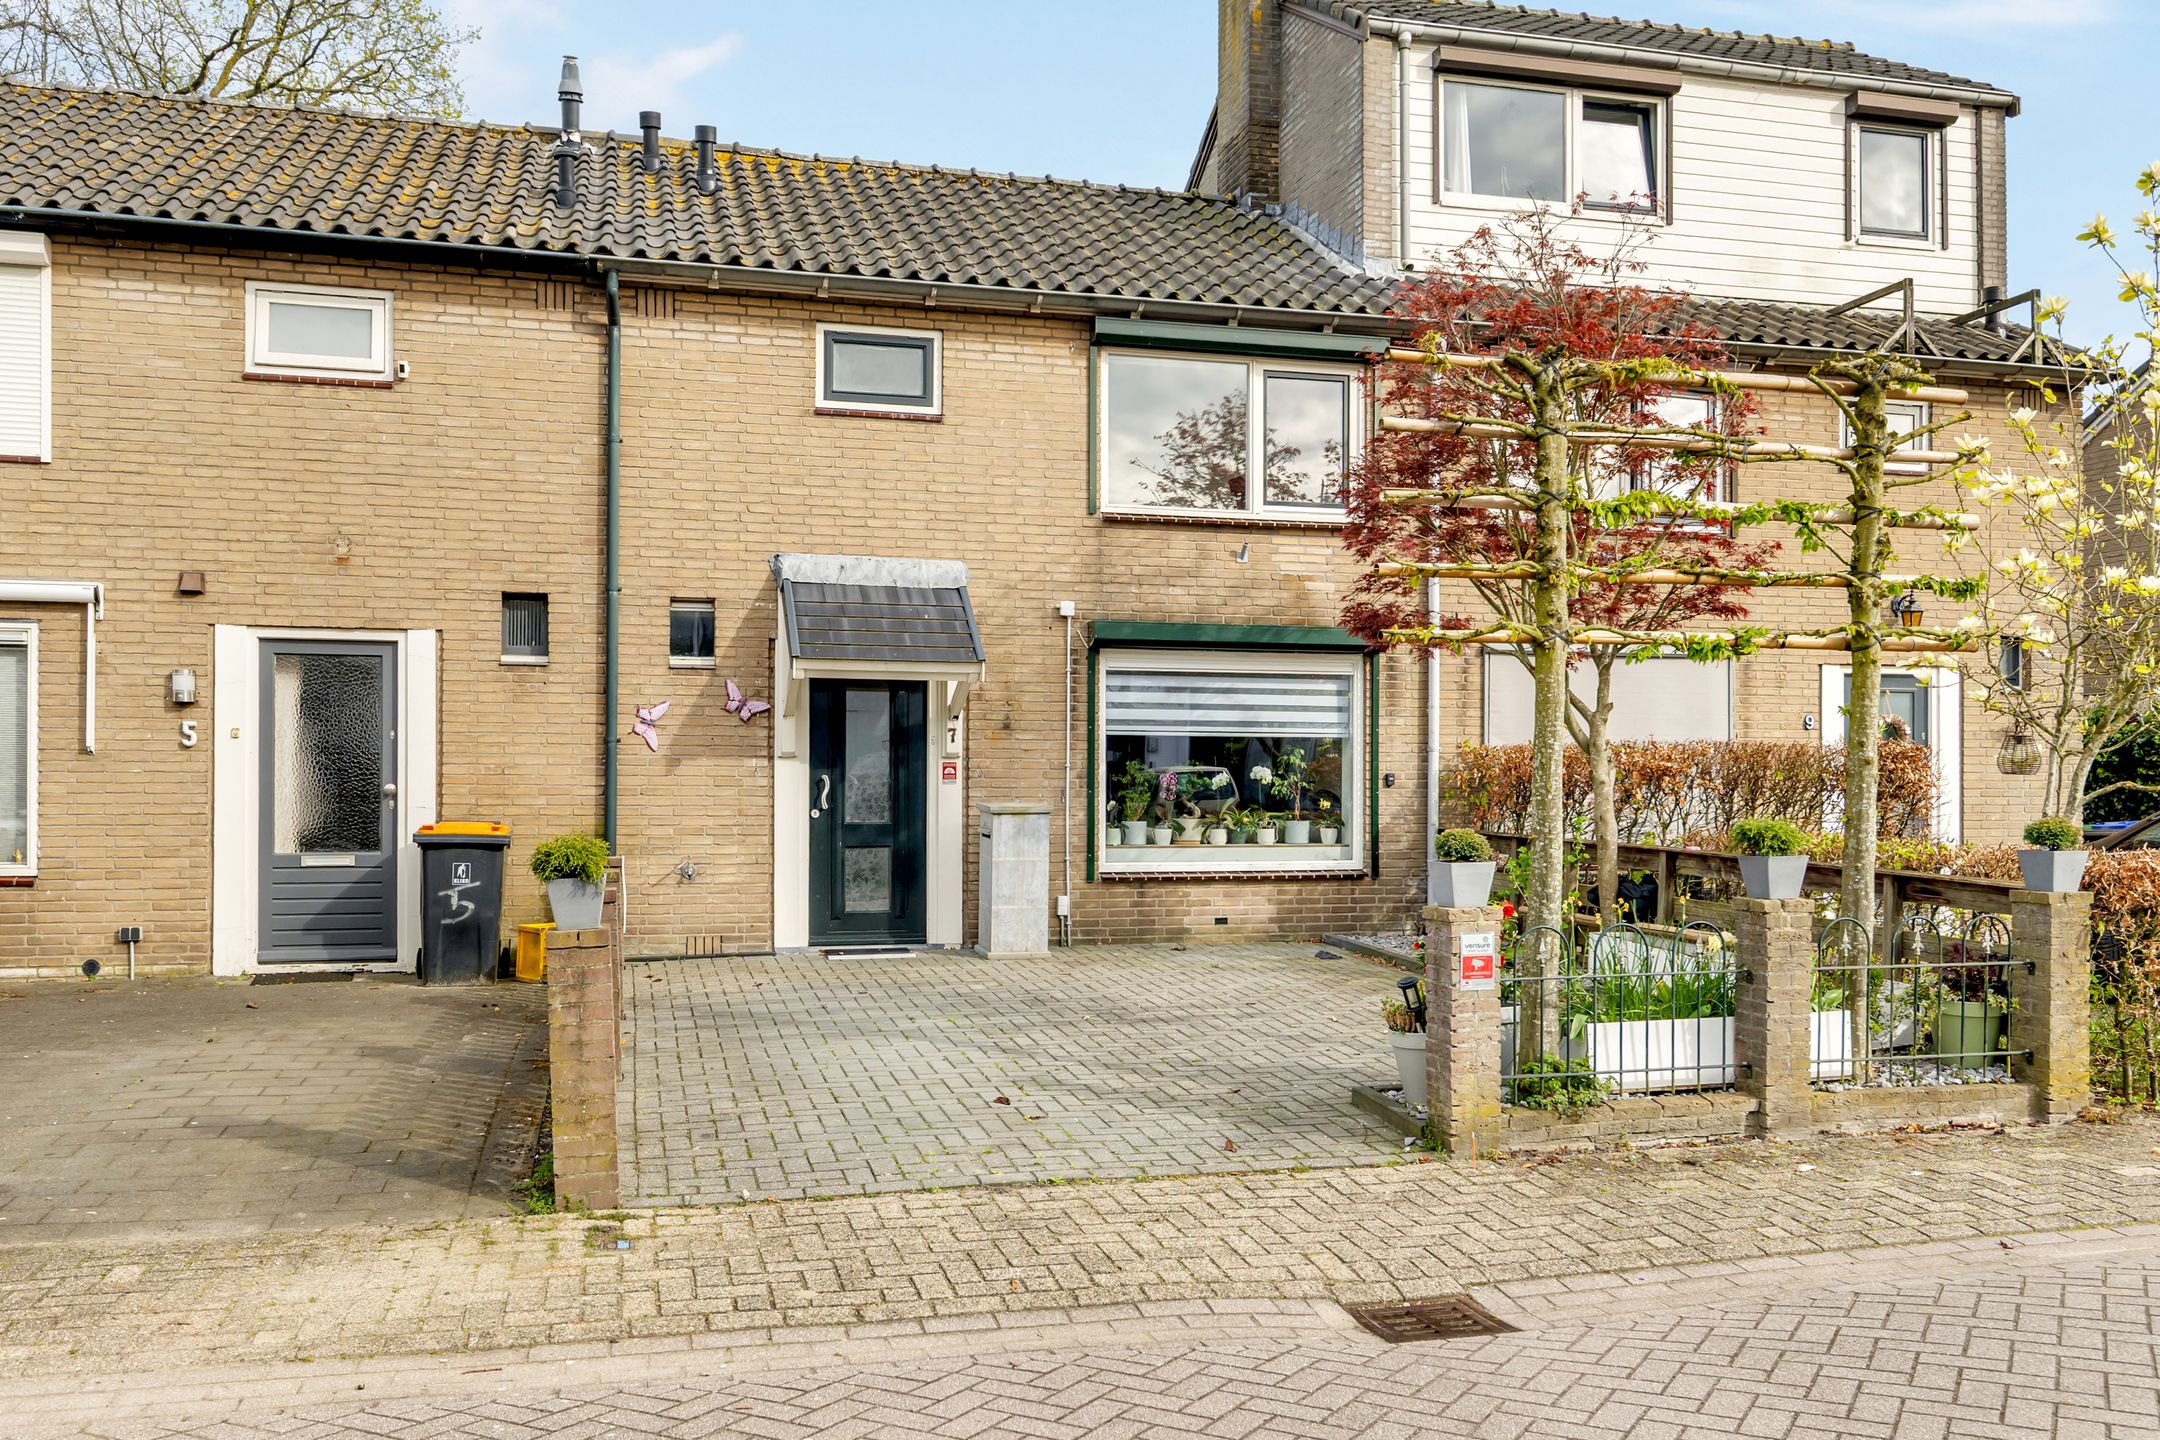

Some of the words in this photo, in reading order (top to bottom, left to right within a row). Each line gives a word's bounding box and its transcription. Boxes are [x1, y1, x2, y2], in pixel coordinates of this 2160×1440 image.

[1804, 714, 1814, 730] 9
[182, 720, 197, 747] 5
[947, 728, 957, 743] 7
[438, 881, 481, 924] 5
